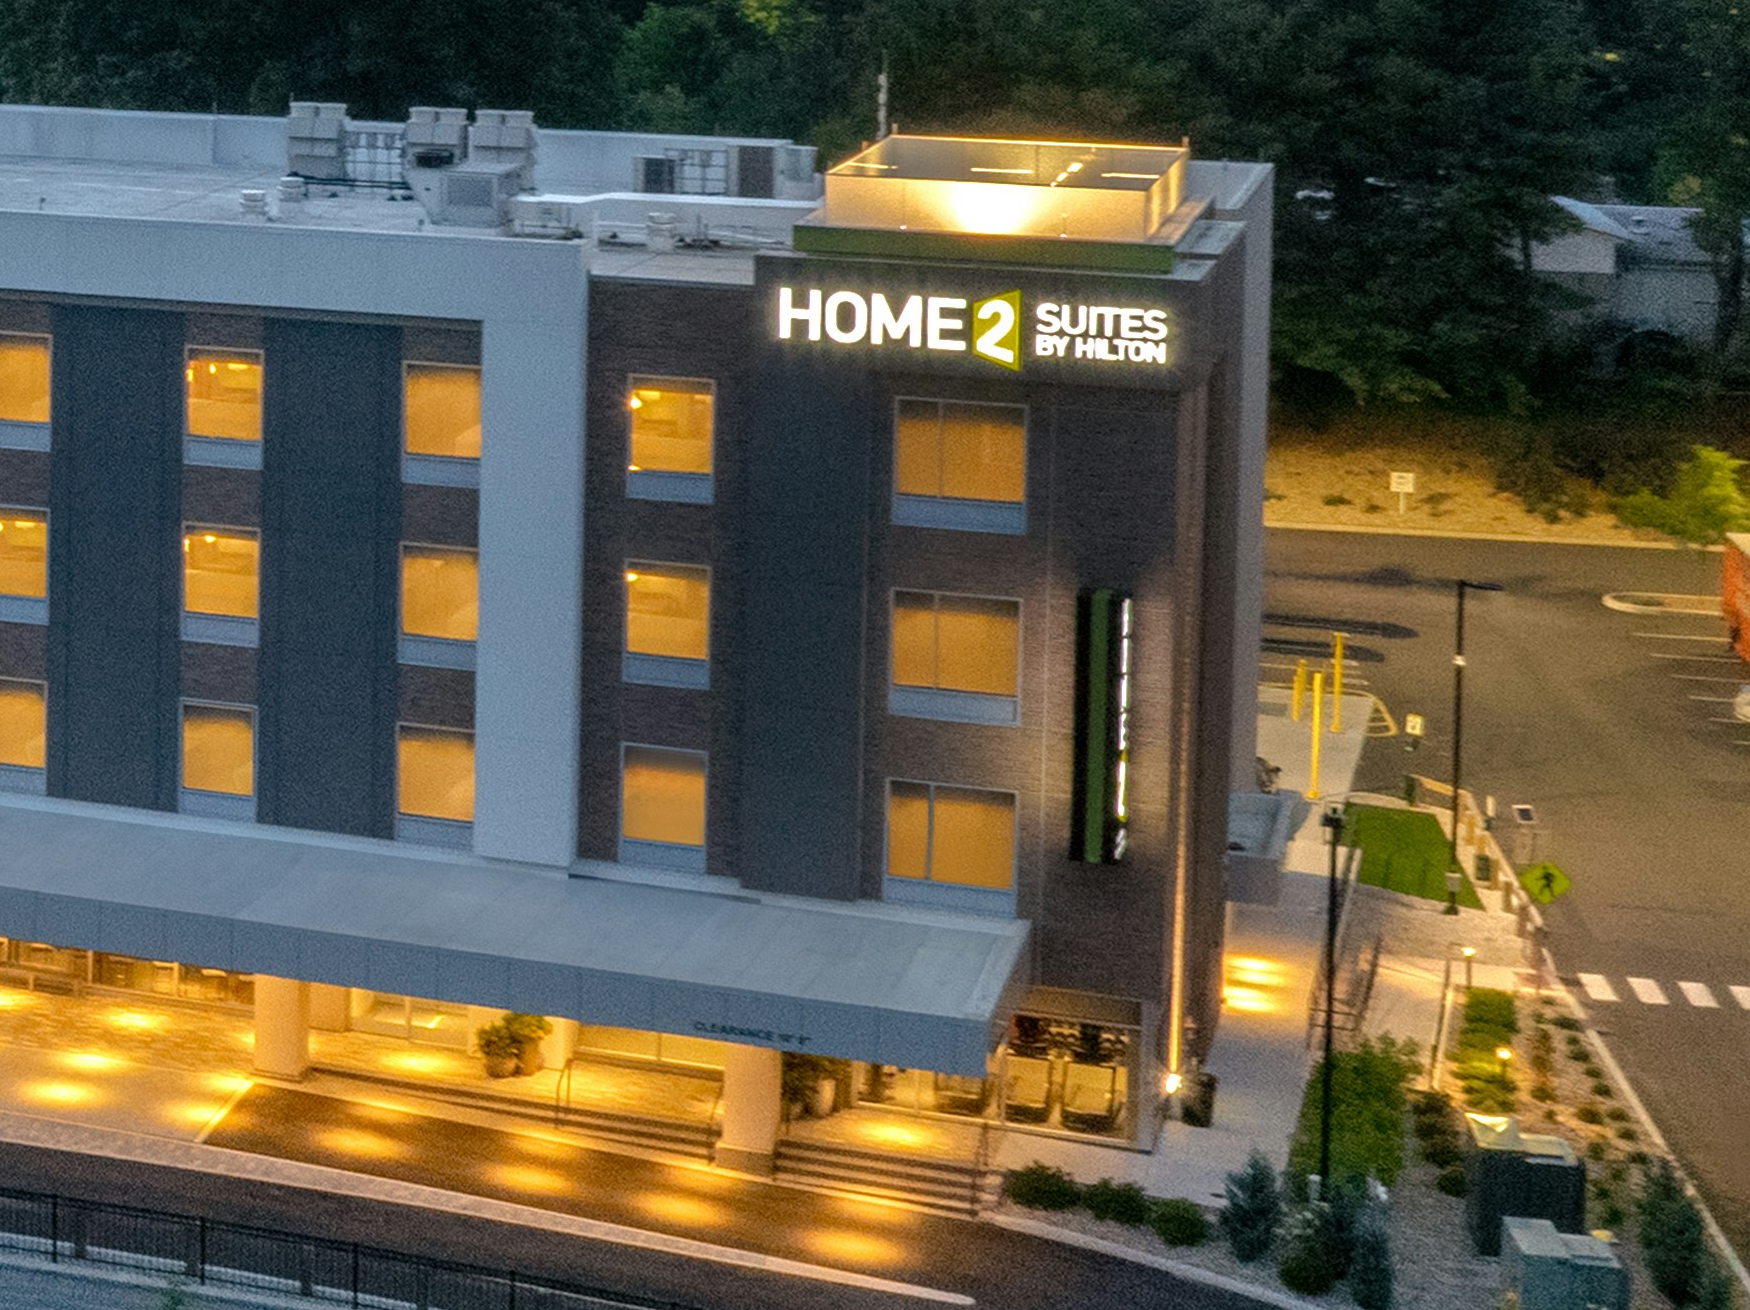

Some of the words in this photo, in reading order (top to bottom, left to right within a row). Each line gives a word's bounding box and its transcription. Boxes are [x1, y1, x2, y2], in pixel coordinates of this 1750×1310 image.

[1035, 302, 1168, 341] SUITES
[1035, 334, 1071, 358] BY
[1074, 337, 1167, 364] HILTON
[693, 1020, 773, 1041] CLEARANCE
